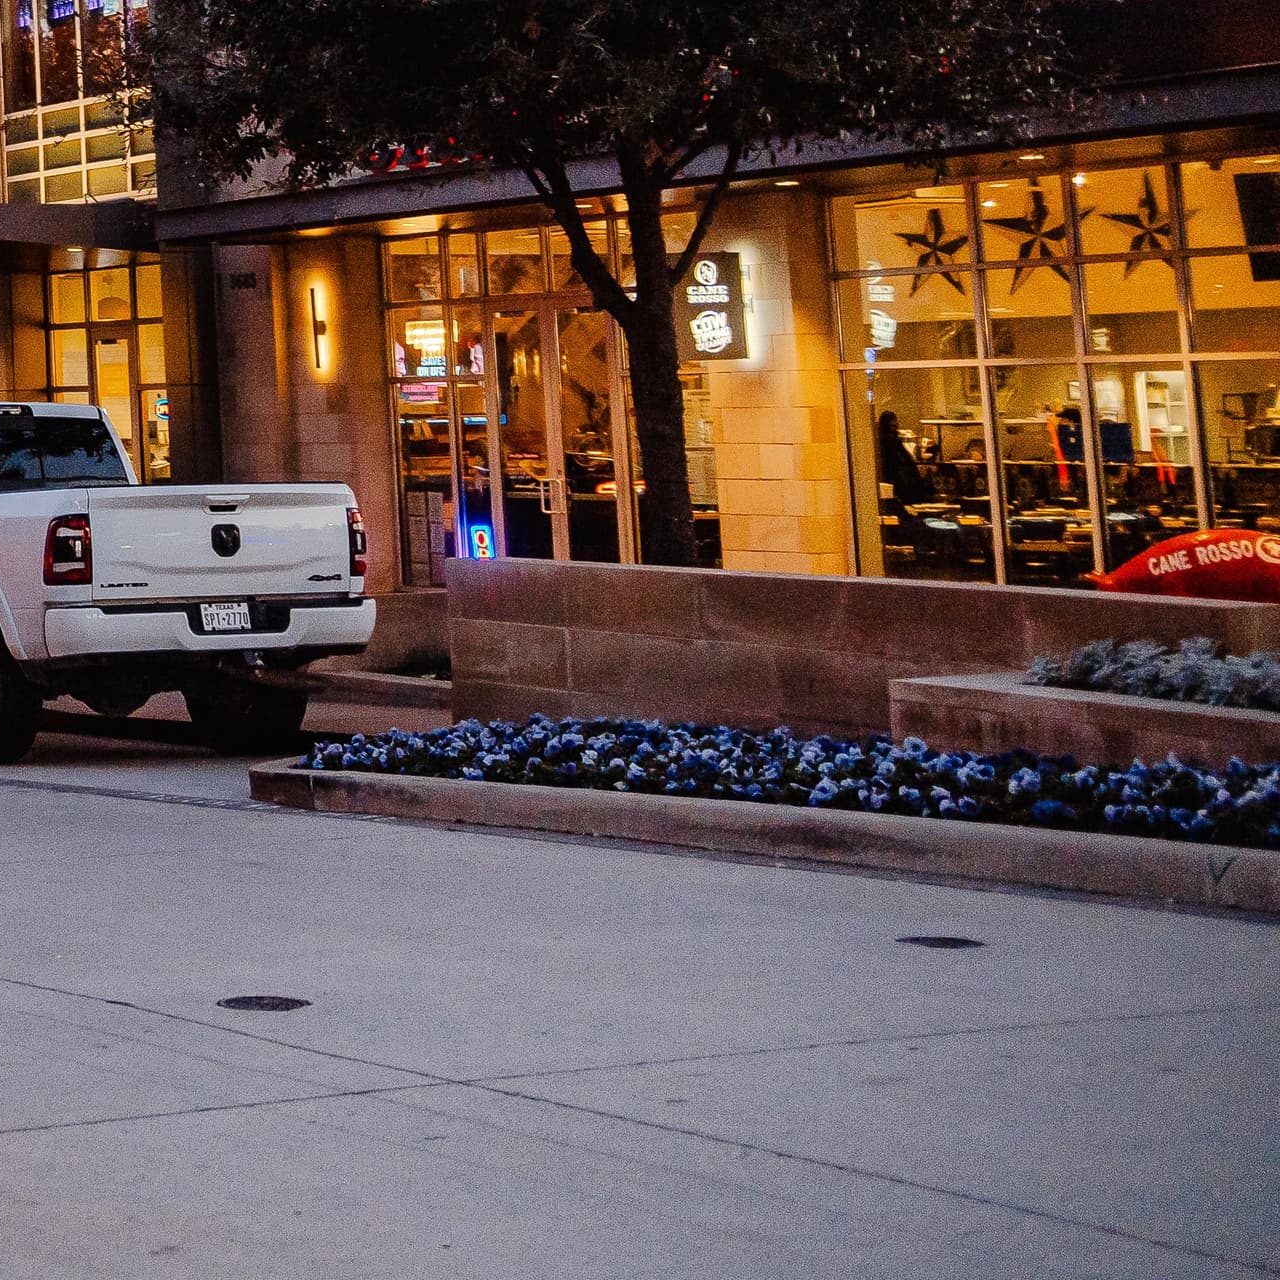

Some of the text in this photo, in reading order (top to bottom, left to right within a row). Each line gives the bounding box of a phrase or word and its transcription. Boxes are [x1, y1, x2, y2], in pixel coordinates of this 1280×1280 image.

[686, 286, 729, 295] CANE
[688, 295, 730, 304] ROSSO
[1148, 540, 1254, 576] CANE ROSSO
